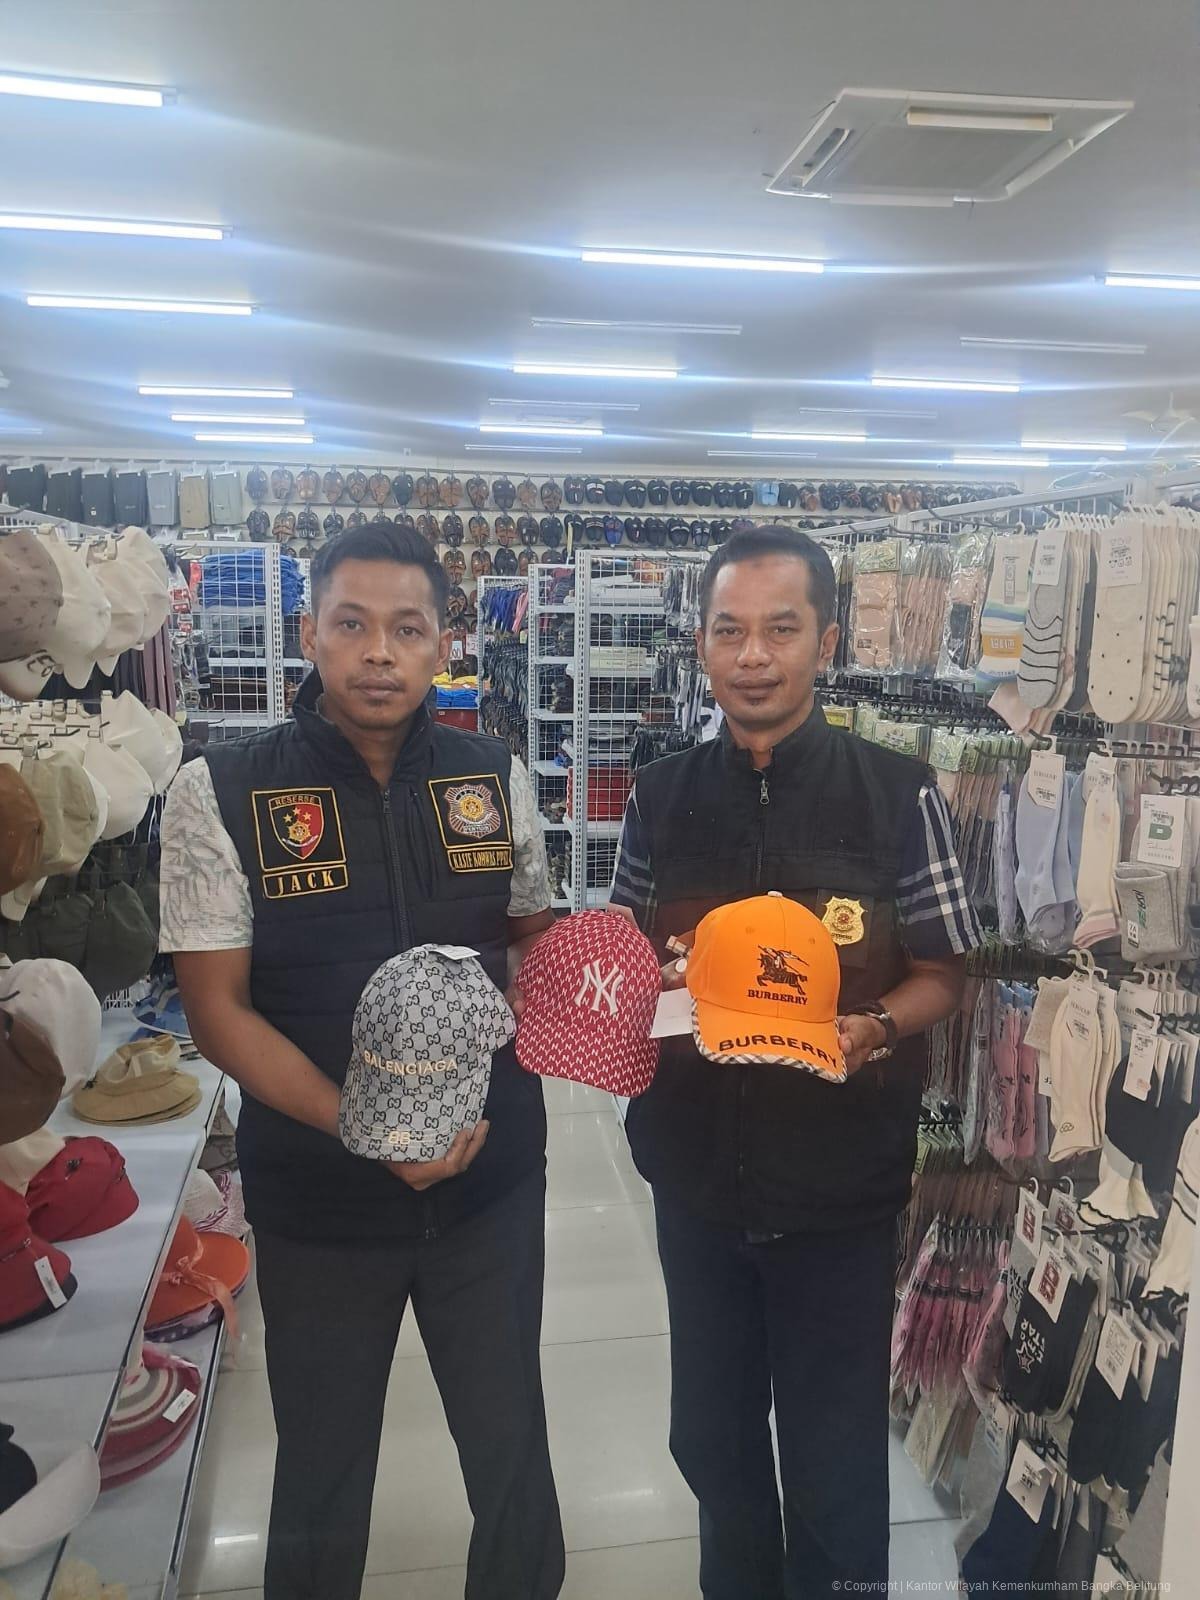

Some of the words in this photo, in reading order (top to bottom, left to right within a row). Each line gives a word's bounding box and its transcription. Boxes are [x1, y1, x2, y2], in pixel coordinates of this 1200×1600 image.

[277, 870, 335, 896] JACK
[574, 958, 625, 1016] NY
[747, 989, 808, 1006] BURBERRY
[363, 1049, 459, 1076] BALENCIAGA
[719, 1034, 837, 1068] BURBERRY
